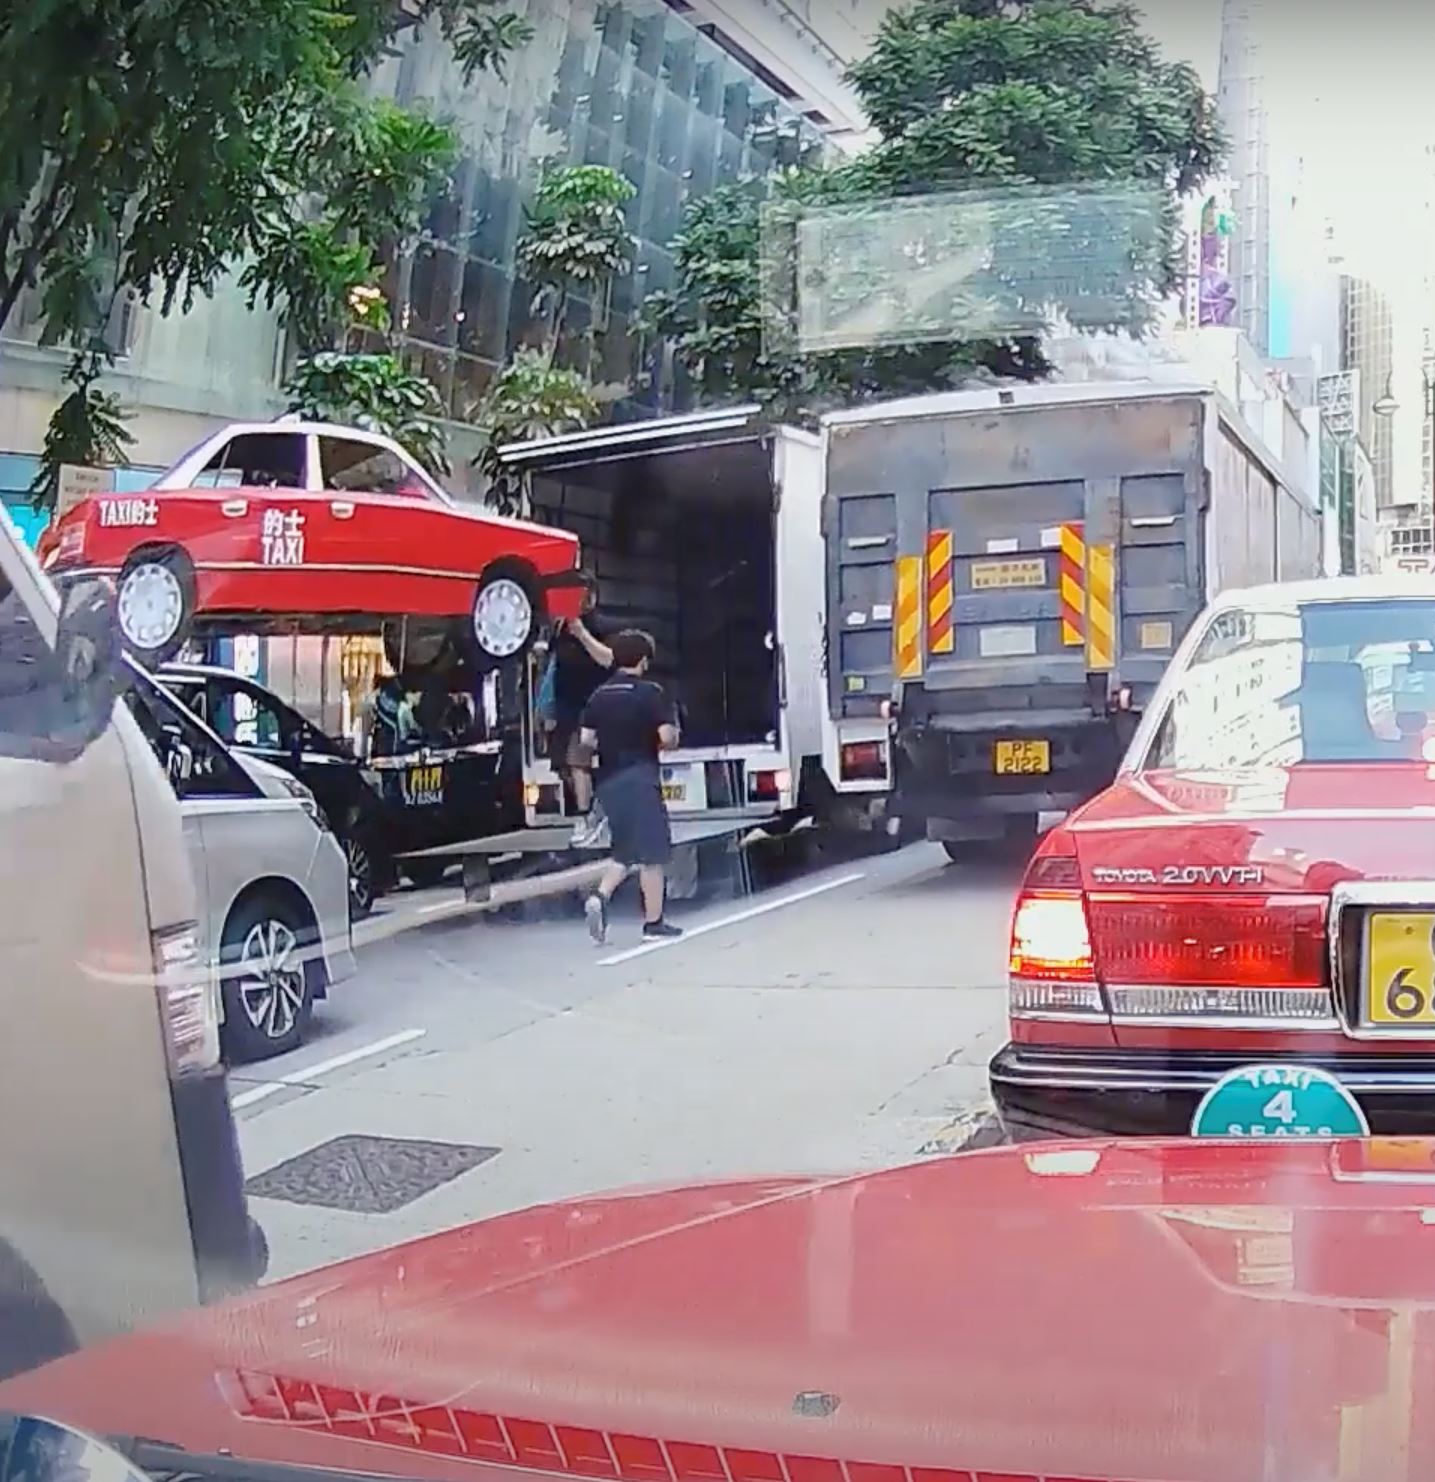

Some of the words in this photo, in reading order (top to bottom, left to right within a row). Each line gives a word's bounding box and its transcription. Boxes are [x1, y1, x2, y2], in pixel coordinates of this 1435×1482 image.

[263, 509, 305, 537] 的士
[261, 536, 305, 566] TAXI
[1003, 756, 1043, 773] 2122
[1093, 867, 1157, 884] TOYOTA
[1246, 1069, 1314, 1091] TAXI
[1262, 1089, 1298, 1125] 4
[1227, 1123, 1333, 1137] SEATS
